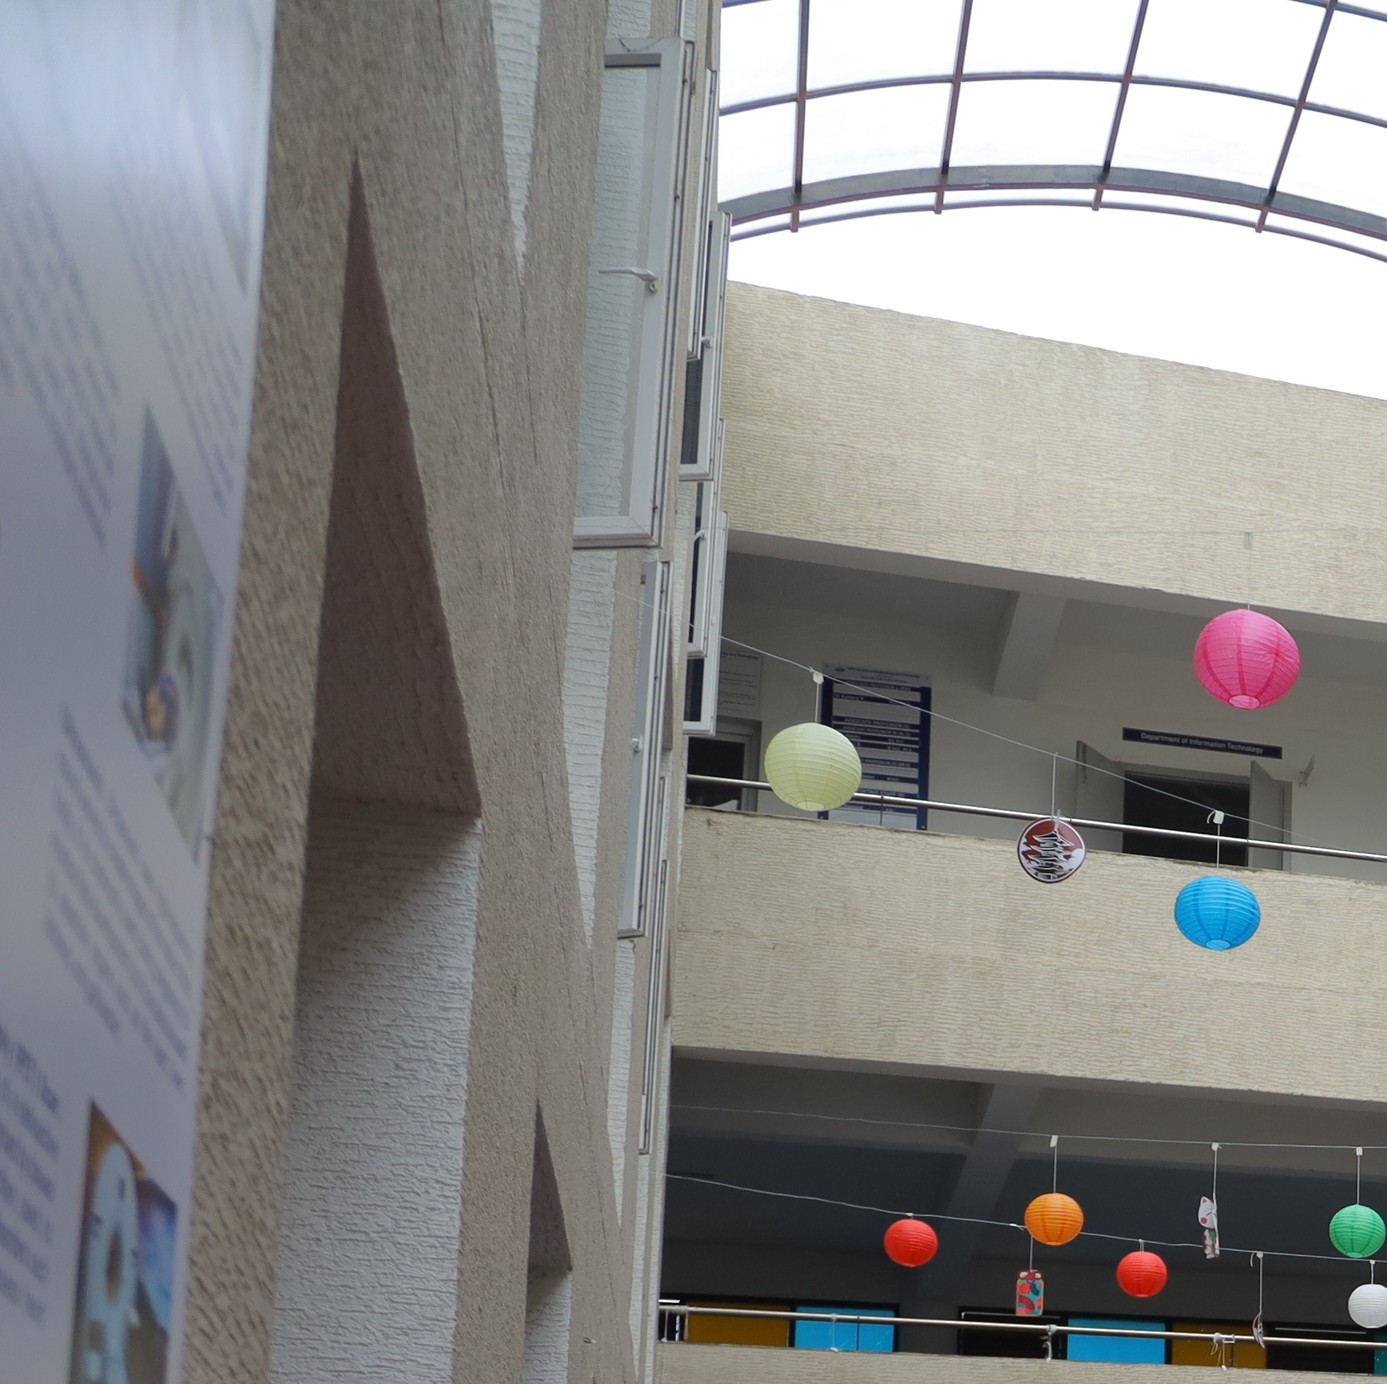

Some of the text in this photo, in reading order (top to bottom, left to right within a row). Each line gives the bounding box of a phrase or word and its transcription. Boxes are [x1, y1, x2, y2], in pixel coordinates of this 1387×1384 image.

[1141, 732, 1180, 743] Department
[1189, 738, 1225, 749] Information
[1228, 743, 1263, 753] Technology
